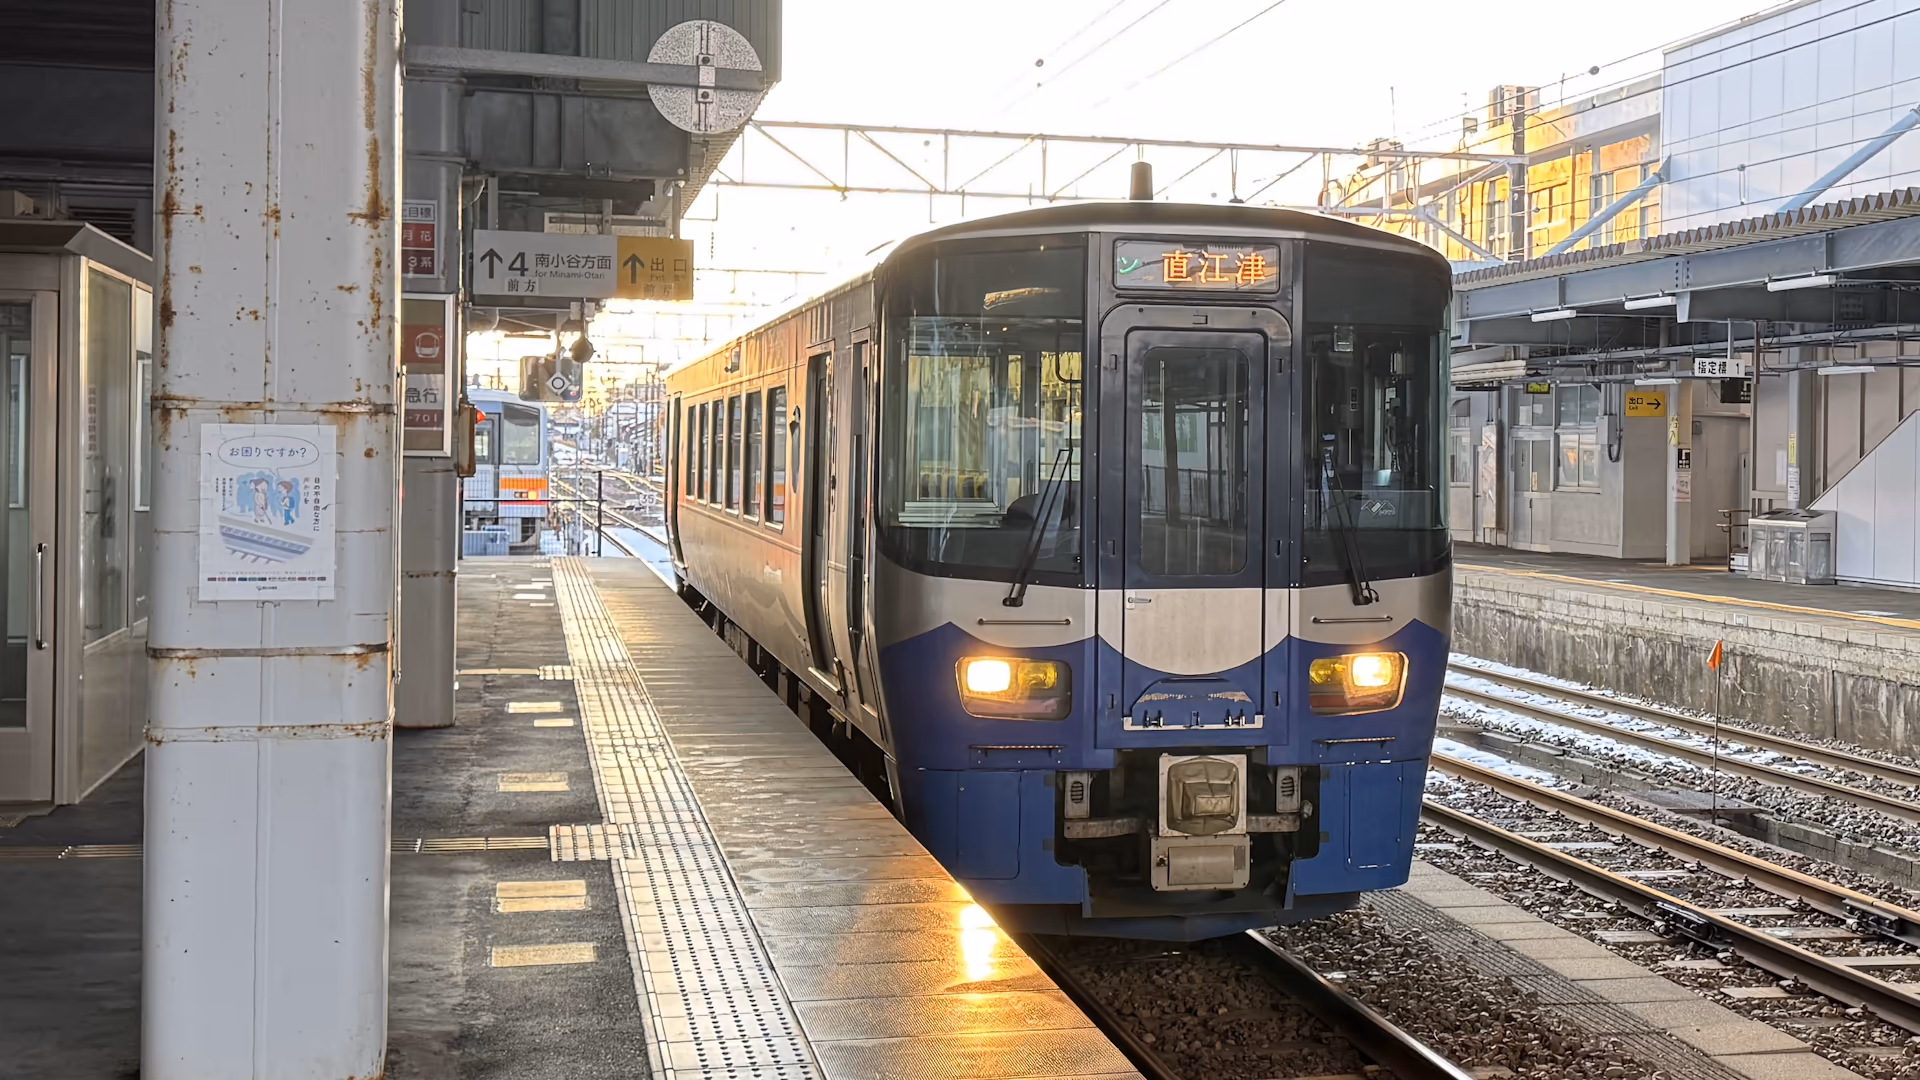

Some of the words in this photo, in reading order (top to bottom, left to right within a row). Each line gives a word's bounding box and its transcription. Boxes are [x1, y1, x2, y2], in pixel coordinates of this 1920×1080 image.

[508, 251, 529, 277] 4
[535, 253, 612, 270] 南小谷方面
[651, 257, 686, 272] 出口
[1161, 249, 1266, 285] 直江津
[535, 269, 547, 278] for
[549, 270, 605, 280] Minami-Otari
[507, 278, 536, 292] 前方
[1698, 361, 1727, 375] 指定標
[1736, 362, 1740, 375] 1
[1628, 397, 1644, 405] 出口
[229, 447, 307, 458] お困りですか?
